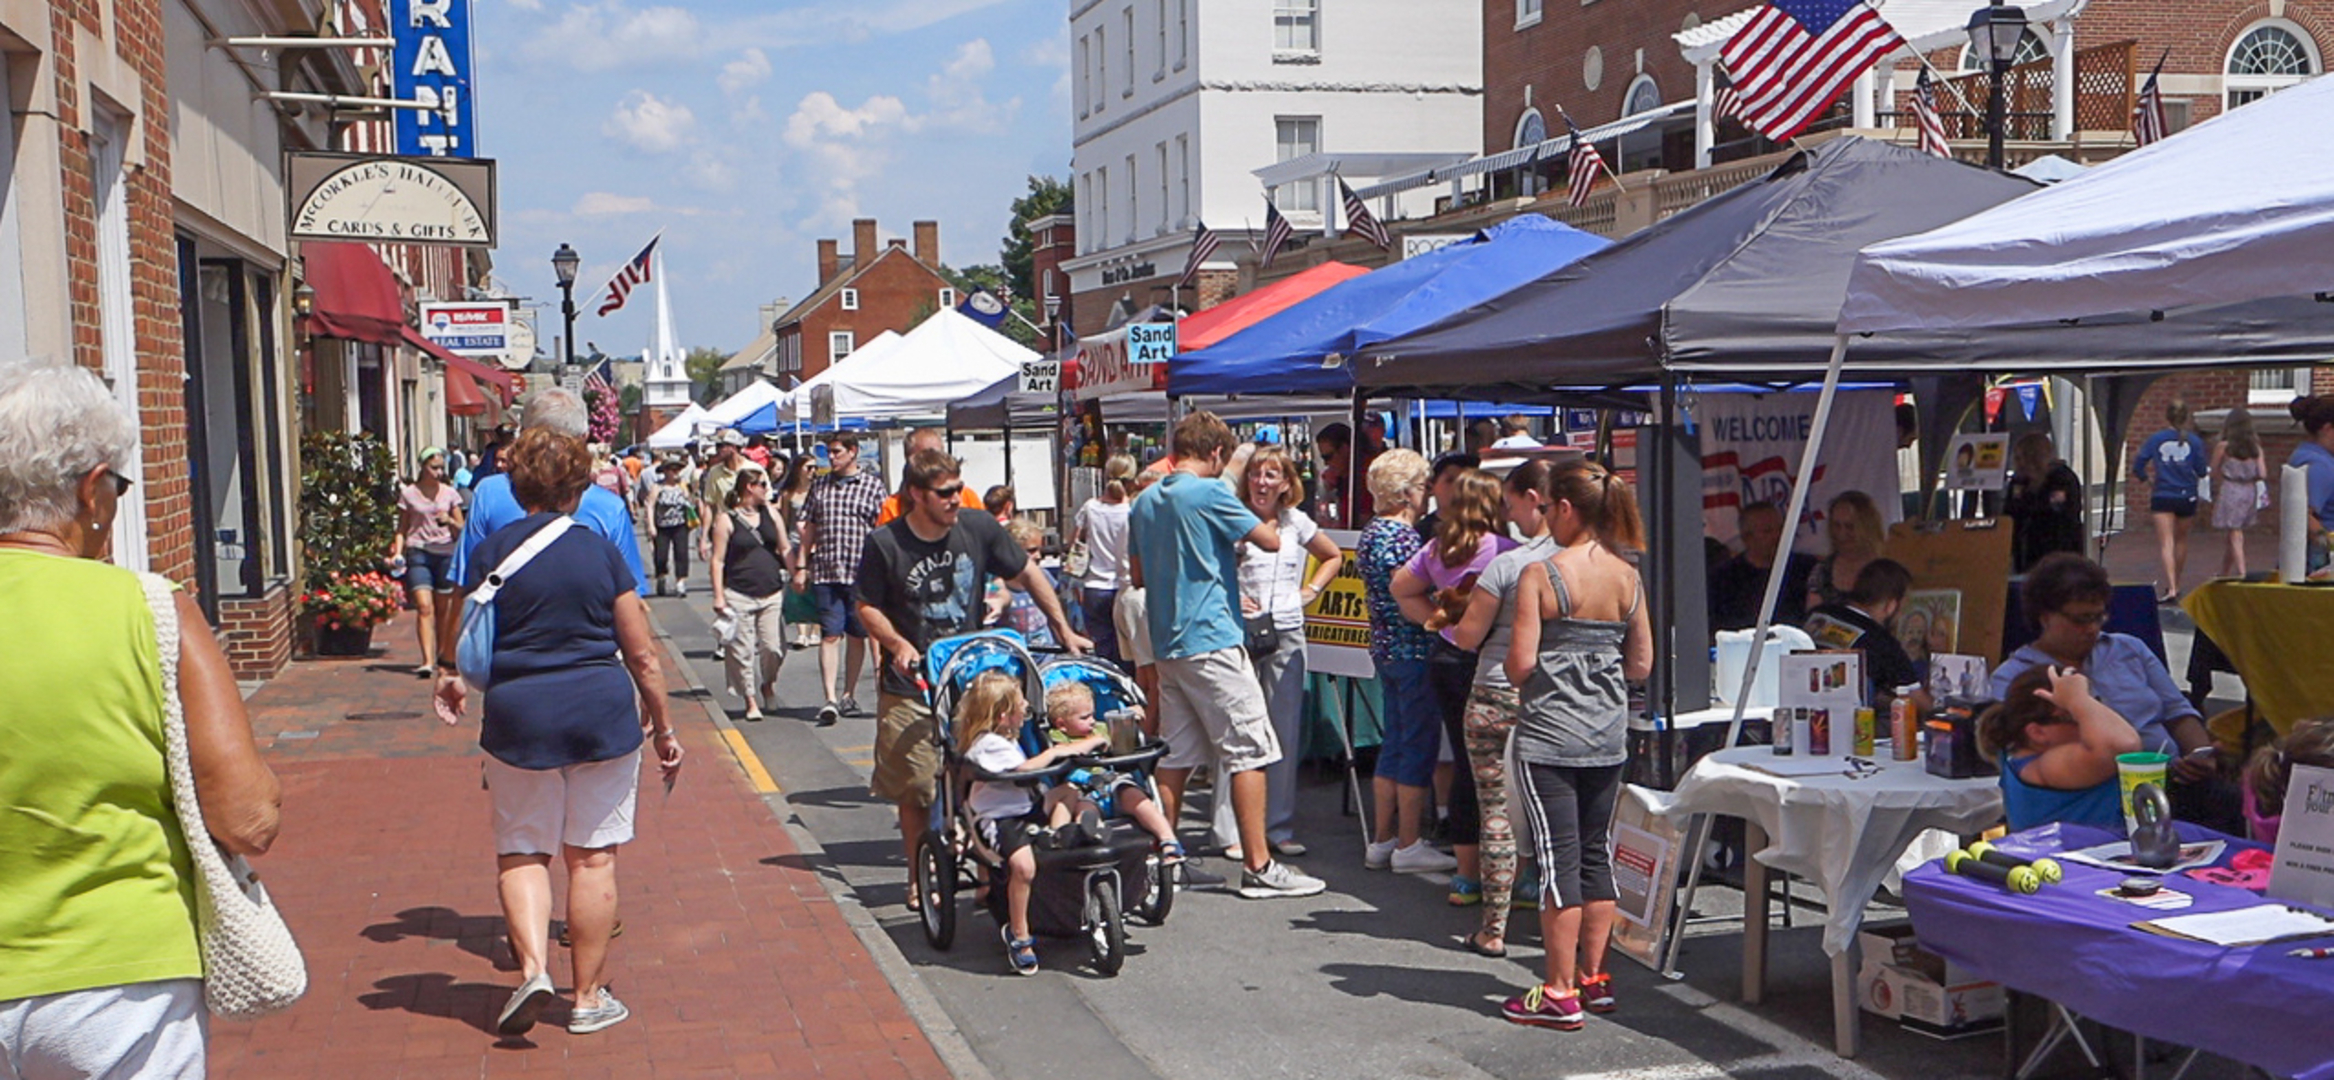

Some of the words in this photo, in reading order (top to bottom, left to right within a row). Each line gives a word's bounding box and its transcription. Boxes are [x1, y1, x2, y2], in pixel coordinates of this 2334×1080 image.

[327, 219, 384, 235] CARDS
[391, 222, 403, 236] &
[410, 223, 456, 238] GIFTS
[1130, 325, 1173, 343] Sand
[1137, 345, 1168, 360] Art
[1022, 361, 1057, 377] Sand
[1077, 342, 1117, 389] SAND
[1027, 378, 1052, 391] Art
[1712, 414, 1812, 442] WELCOME
[1304, 624, 1371, 643] ARICATURES
